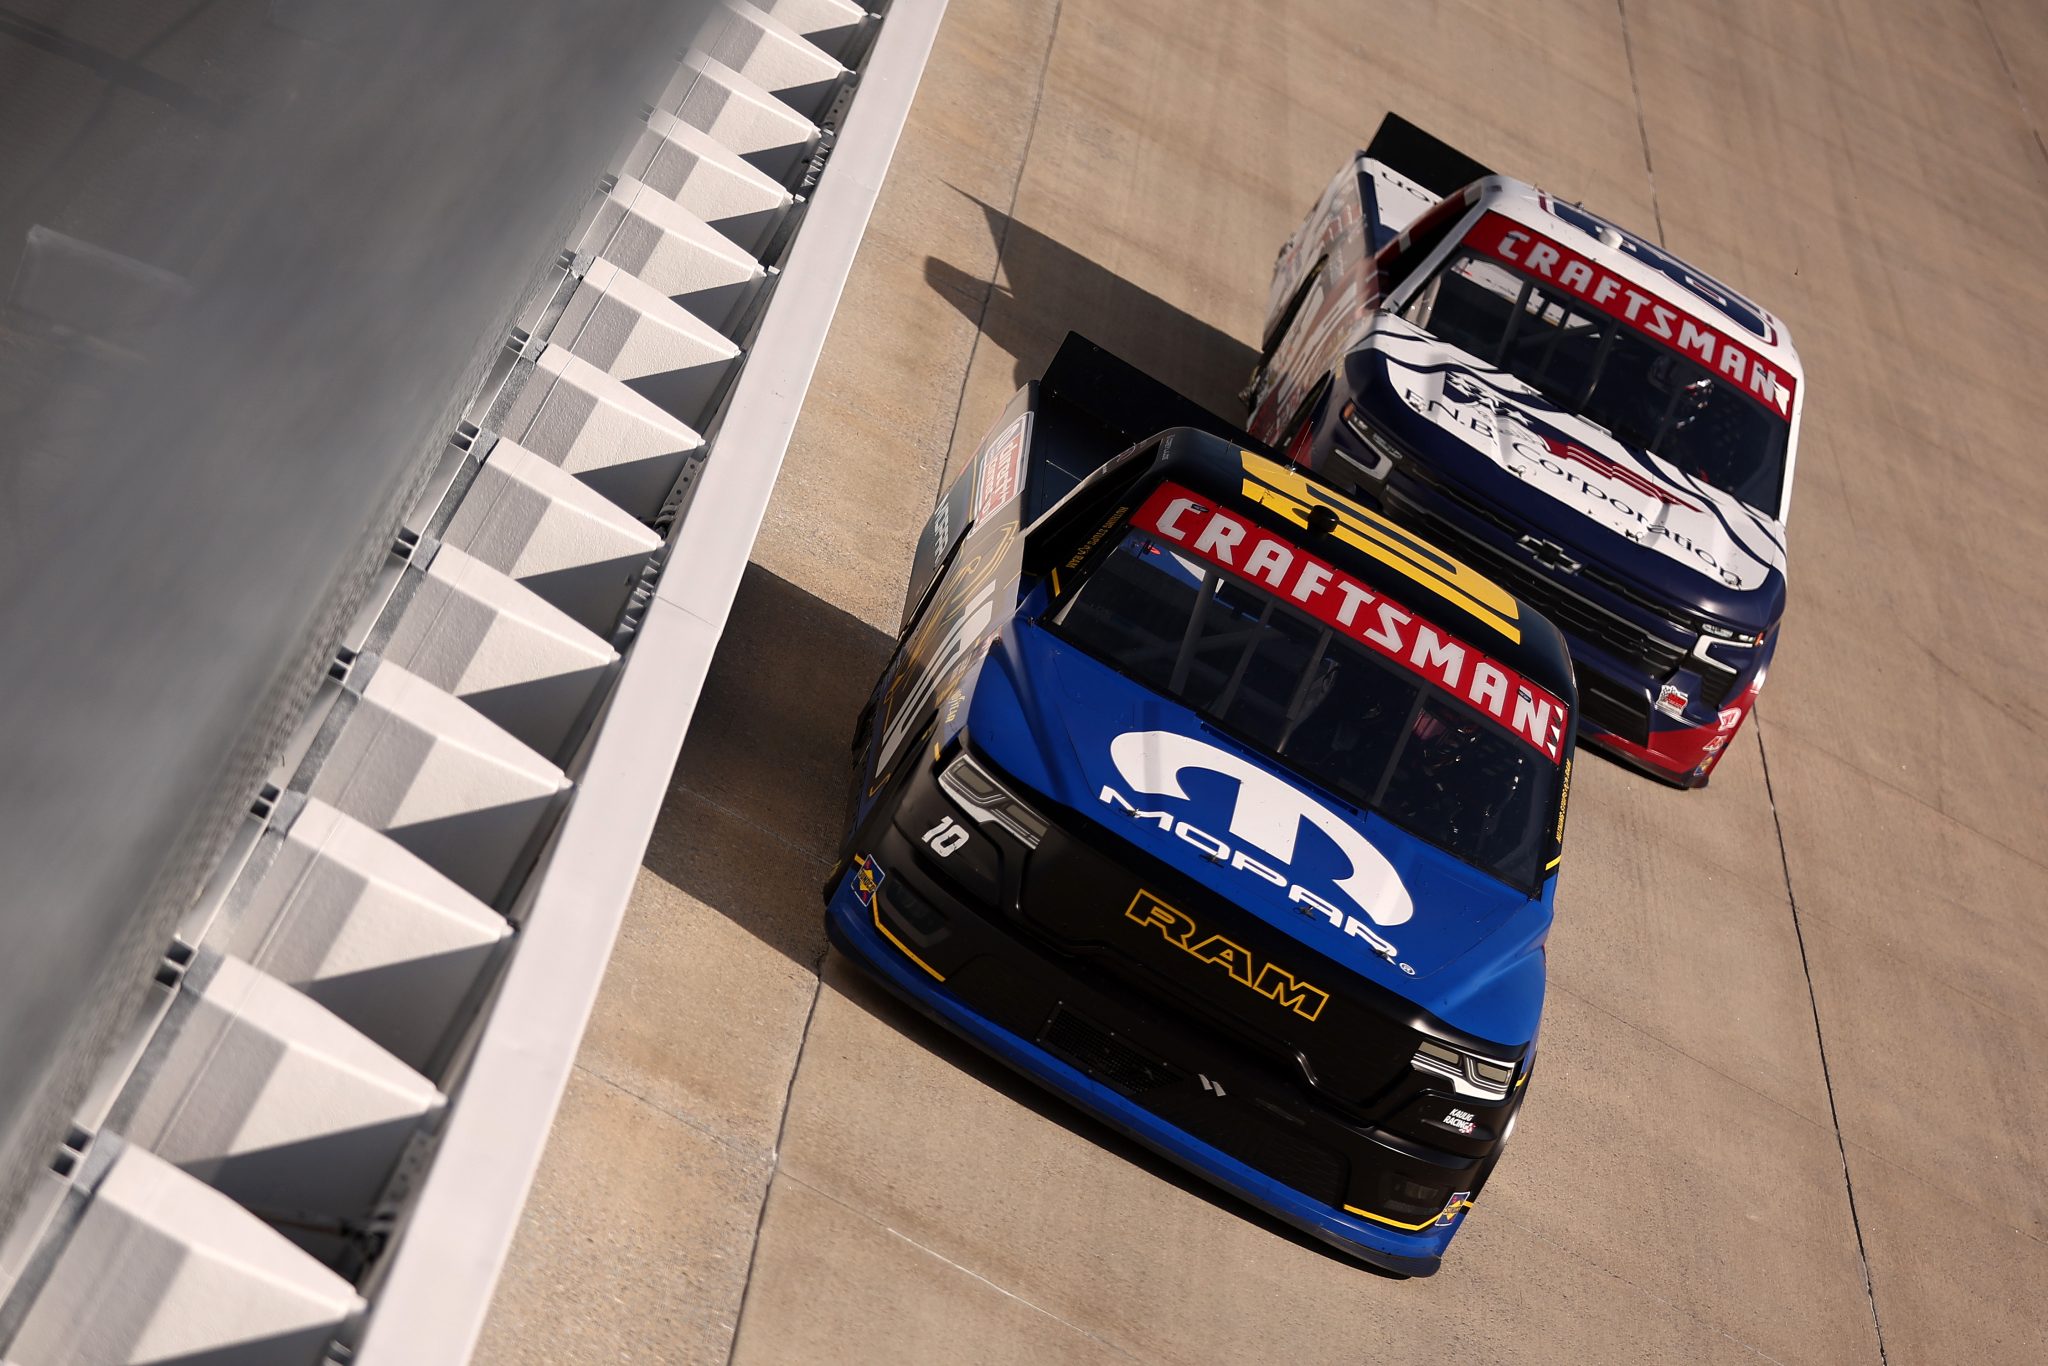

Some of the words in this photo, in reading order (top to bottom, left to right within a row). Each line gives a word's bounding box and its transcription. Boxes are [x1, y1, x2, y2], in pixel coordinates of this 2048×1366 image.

[1498, 230, 1778, 403] CRAFTSMAN
[1406, 387, 1498, 447] FN.B.
[1512, 441, 1743, 584] Corporation
[1155, 498, 1550, 747] CRAFTSMAN
[921, 815, 970, 858] 10
[1099, 784, 1398, 966] MOPAR
[1125, 888, 1330, 1022] RAM
[1442, 1115, 1473, 1131] RACING
[1448, 1107, 1476, 1122] KAULIG
